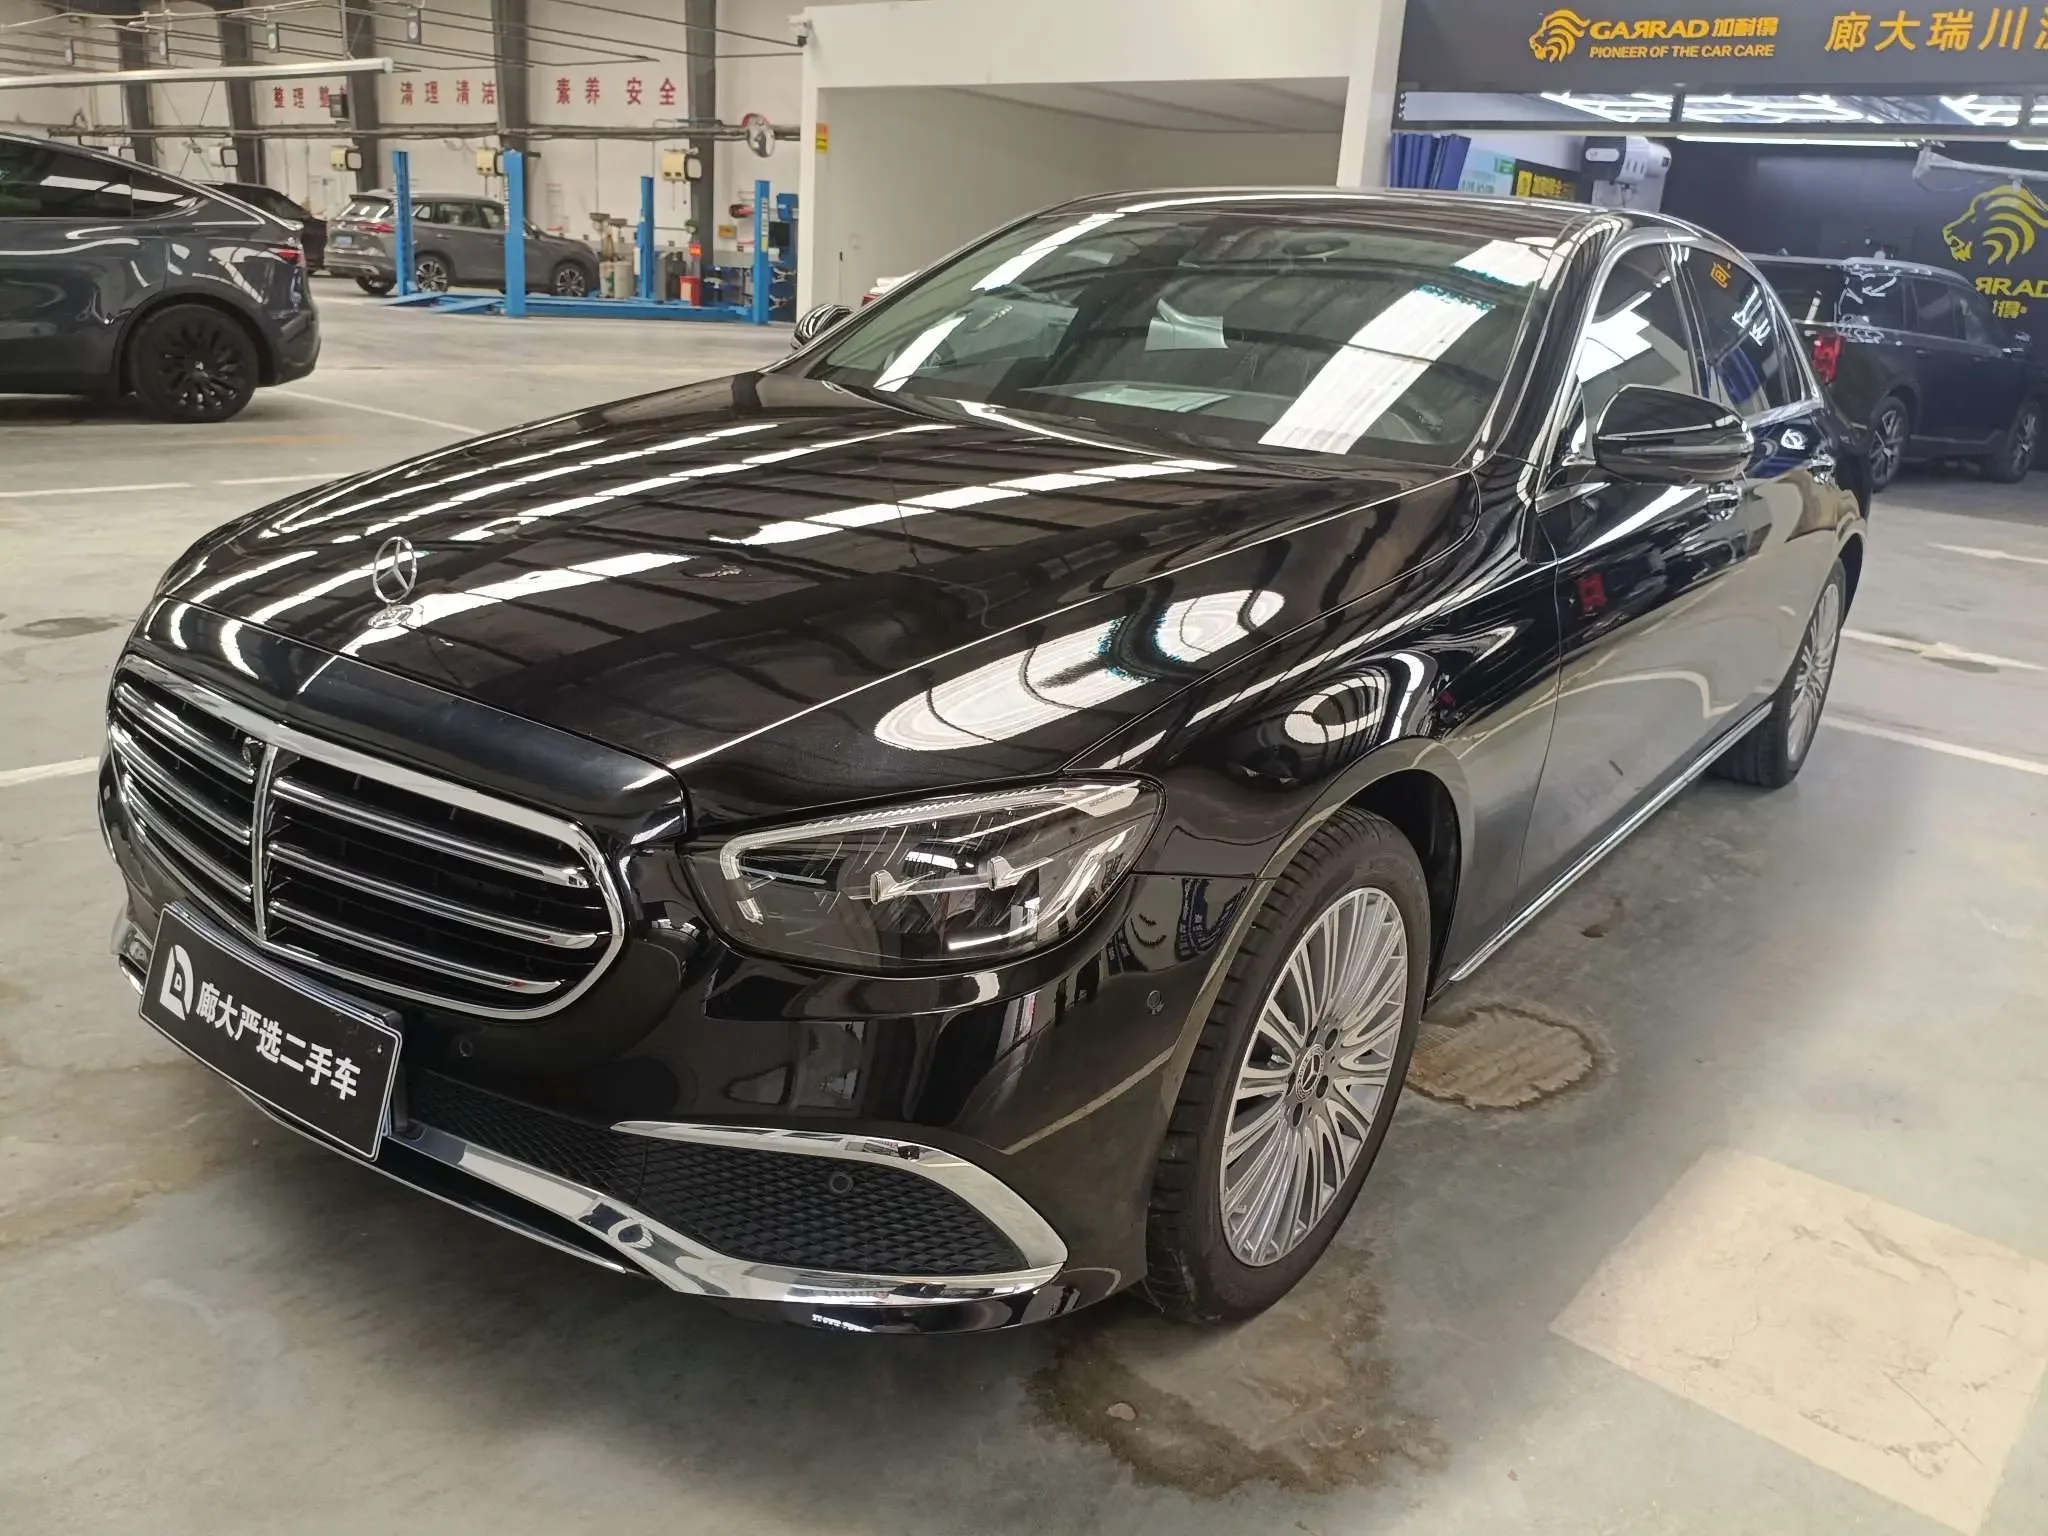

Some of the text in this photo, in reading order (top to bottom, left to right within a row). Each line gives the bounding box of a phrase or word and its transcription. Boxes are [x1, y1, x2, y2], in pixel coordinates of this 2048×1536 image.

[1711, 16, 1780, 38] 加耐得
[1589, 43, 1776, 59] PIONEER OF THE CAR CARE
[196, 980, 361, 1100] 廊大严选二手车
